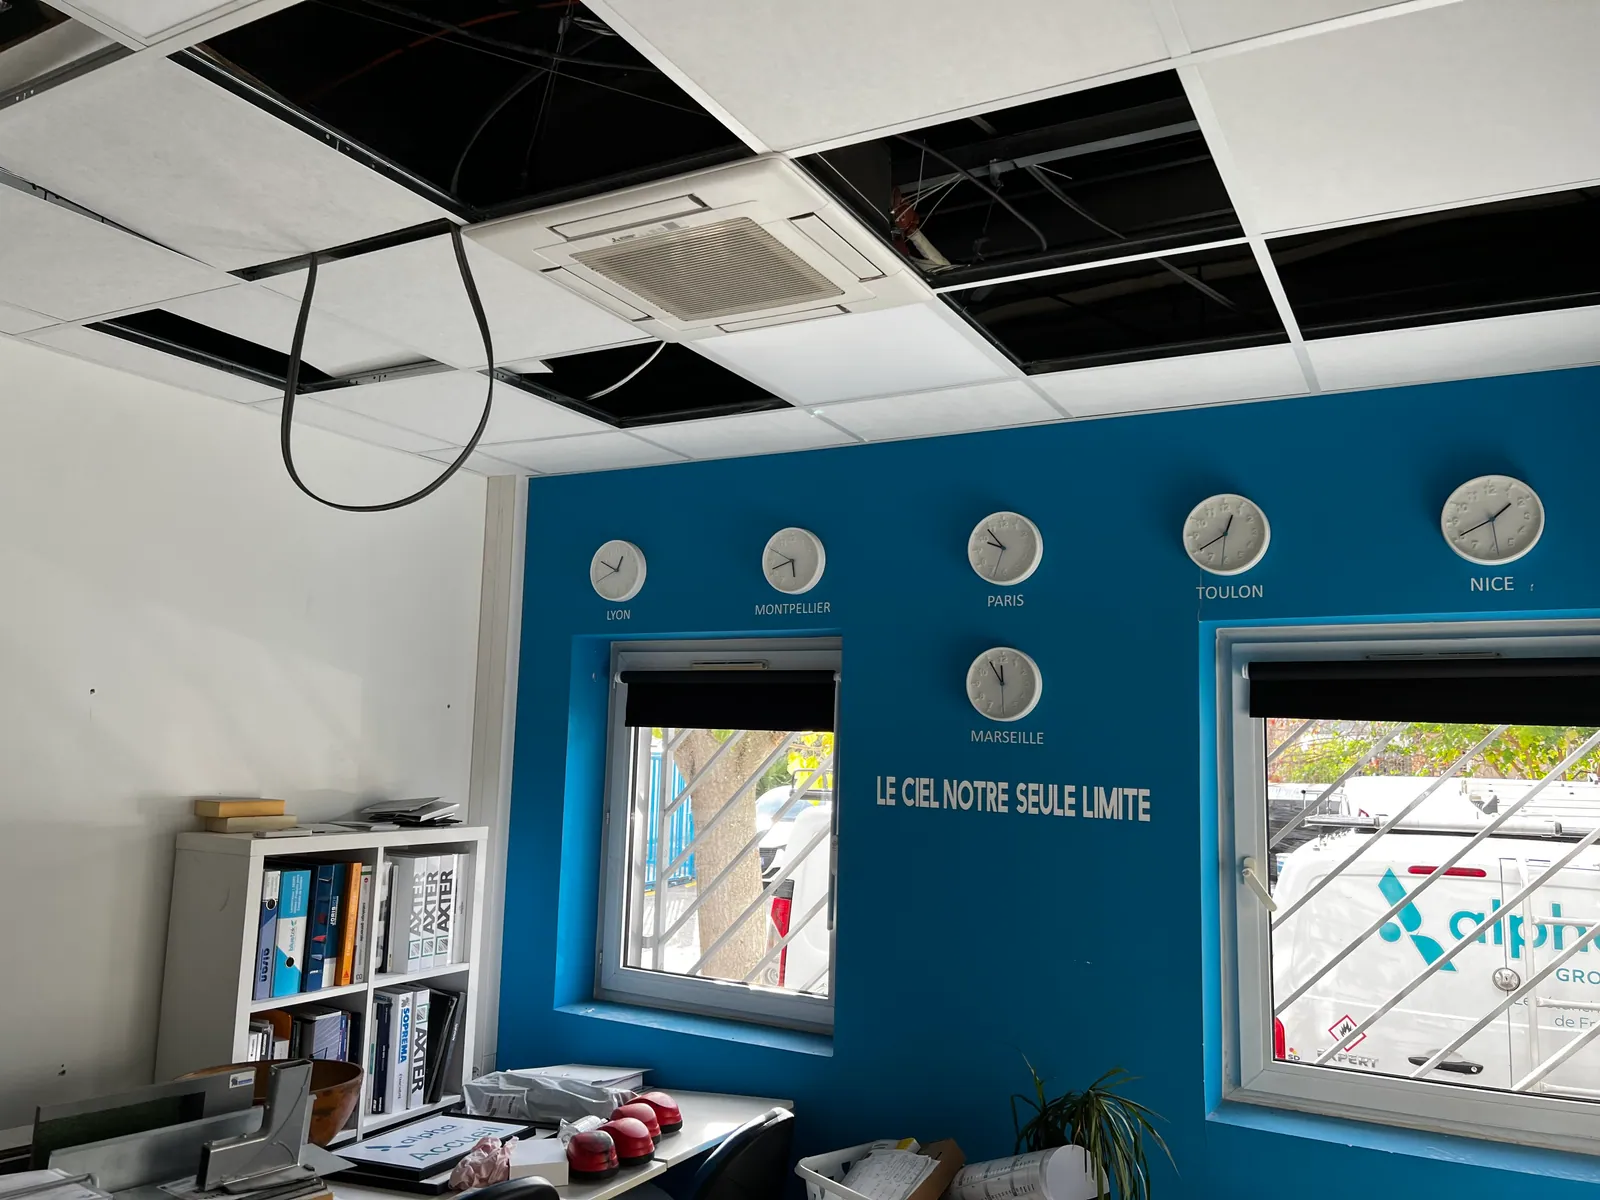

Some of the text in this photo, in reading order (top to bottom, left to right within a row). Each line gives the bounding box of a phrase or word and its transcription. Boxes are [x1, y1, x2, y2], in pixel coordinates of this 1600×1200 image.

[1195, 584, 1264, 600] TOULON
[1470, 576, 1514, 592] NICE
[755, 601, 831, 616] MONTPELLIER
[987, 594, 1024, 607] PARIS
[606, 609, 631, 621] LYON
[970, 730, 1044, 745] MARSEILLE
[876, 775, 1151, 822] LE CIEL NOTRE SEULE LIMITE
[409, 871, 425, 937] AXTER
[423, 870, 439, 934] AXTER
[436, 869, 454, 933] AXTER
[1449, 898, 1600, 959] alph
[400, 1007, 411, 1063] SOPREMA
[1554, 1015, 1575, 1028] de
[411, 1027, 427, 1094] AXTER
[401, 1124, 457, 1144] alpha
[409, 1126, 504, 1161] Accueil
